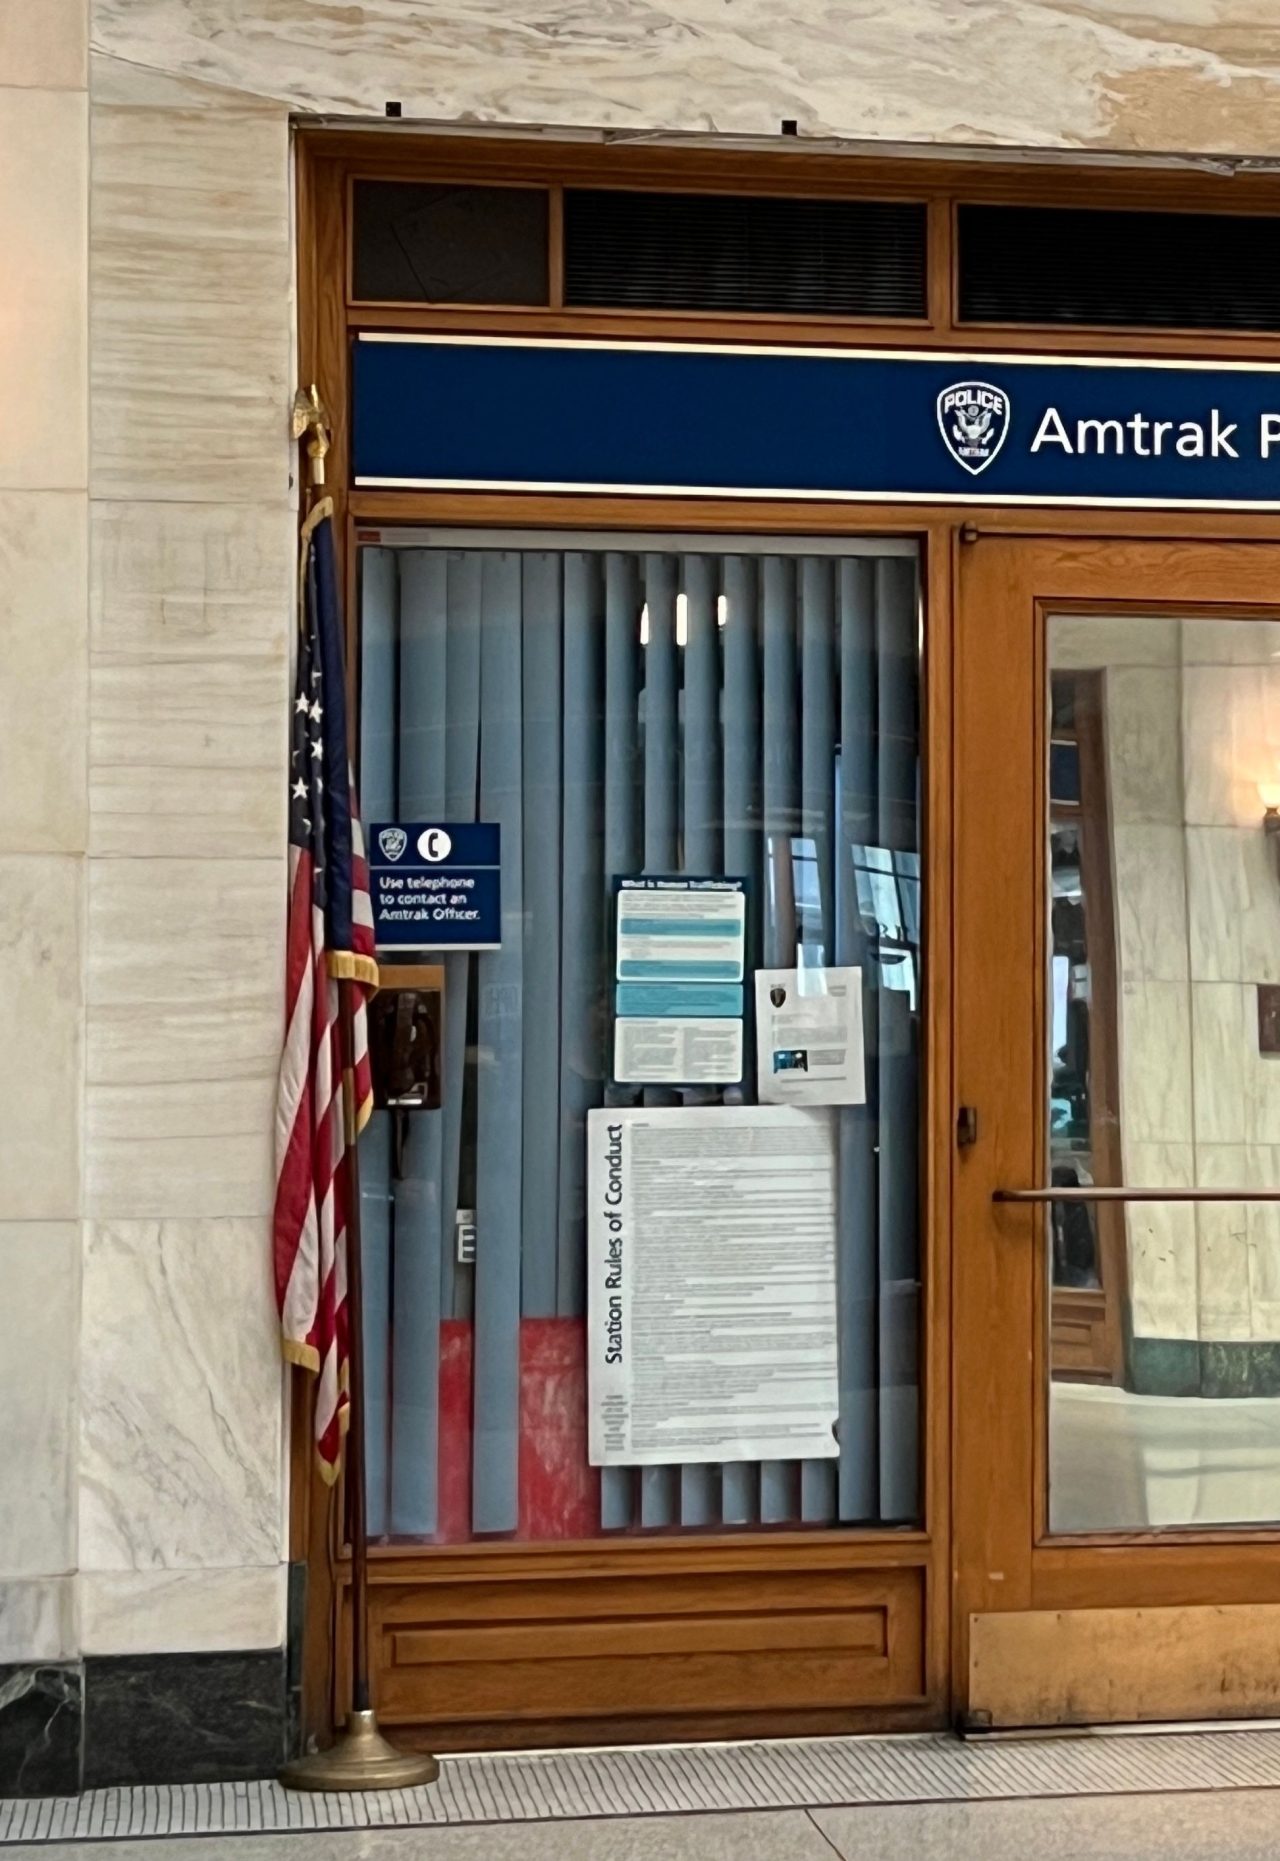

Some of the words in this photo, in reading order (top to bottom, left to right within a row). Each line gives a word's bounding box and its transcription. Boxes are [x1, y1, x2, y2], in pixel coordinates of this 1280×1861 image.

[944, 389, 1003, 415] POLICE
[1030, 407, 1240, 459] Amtrak
[379, 876, 404, 889] Use
[407, 875, 475, 891] telephone
[379, 893, 395, 905] to
[397, 893, 447, 905] contact
[450, 894, 467, 905] an
[379, 908, 429, 920] Amtrak
[432, 907, 480, 920] Officer.
[604, 1124, 623, 1206] Conduct
[603, 1211, 623, 1232] of
[604, 1237, 623, 1289] Rules
[604, 1296, 623, 1364] Station
